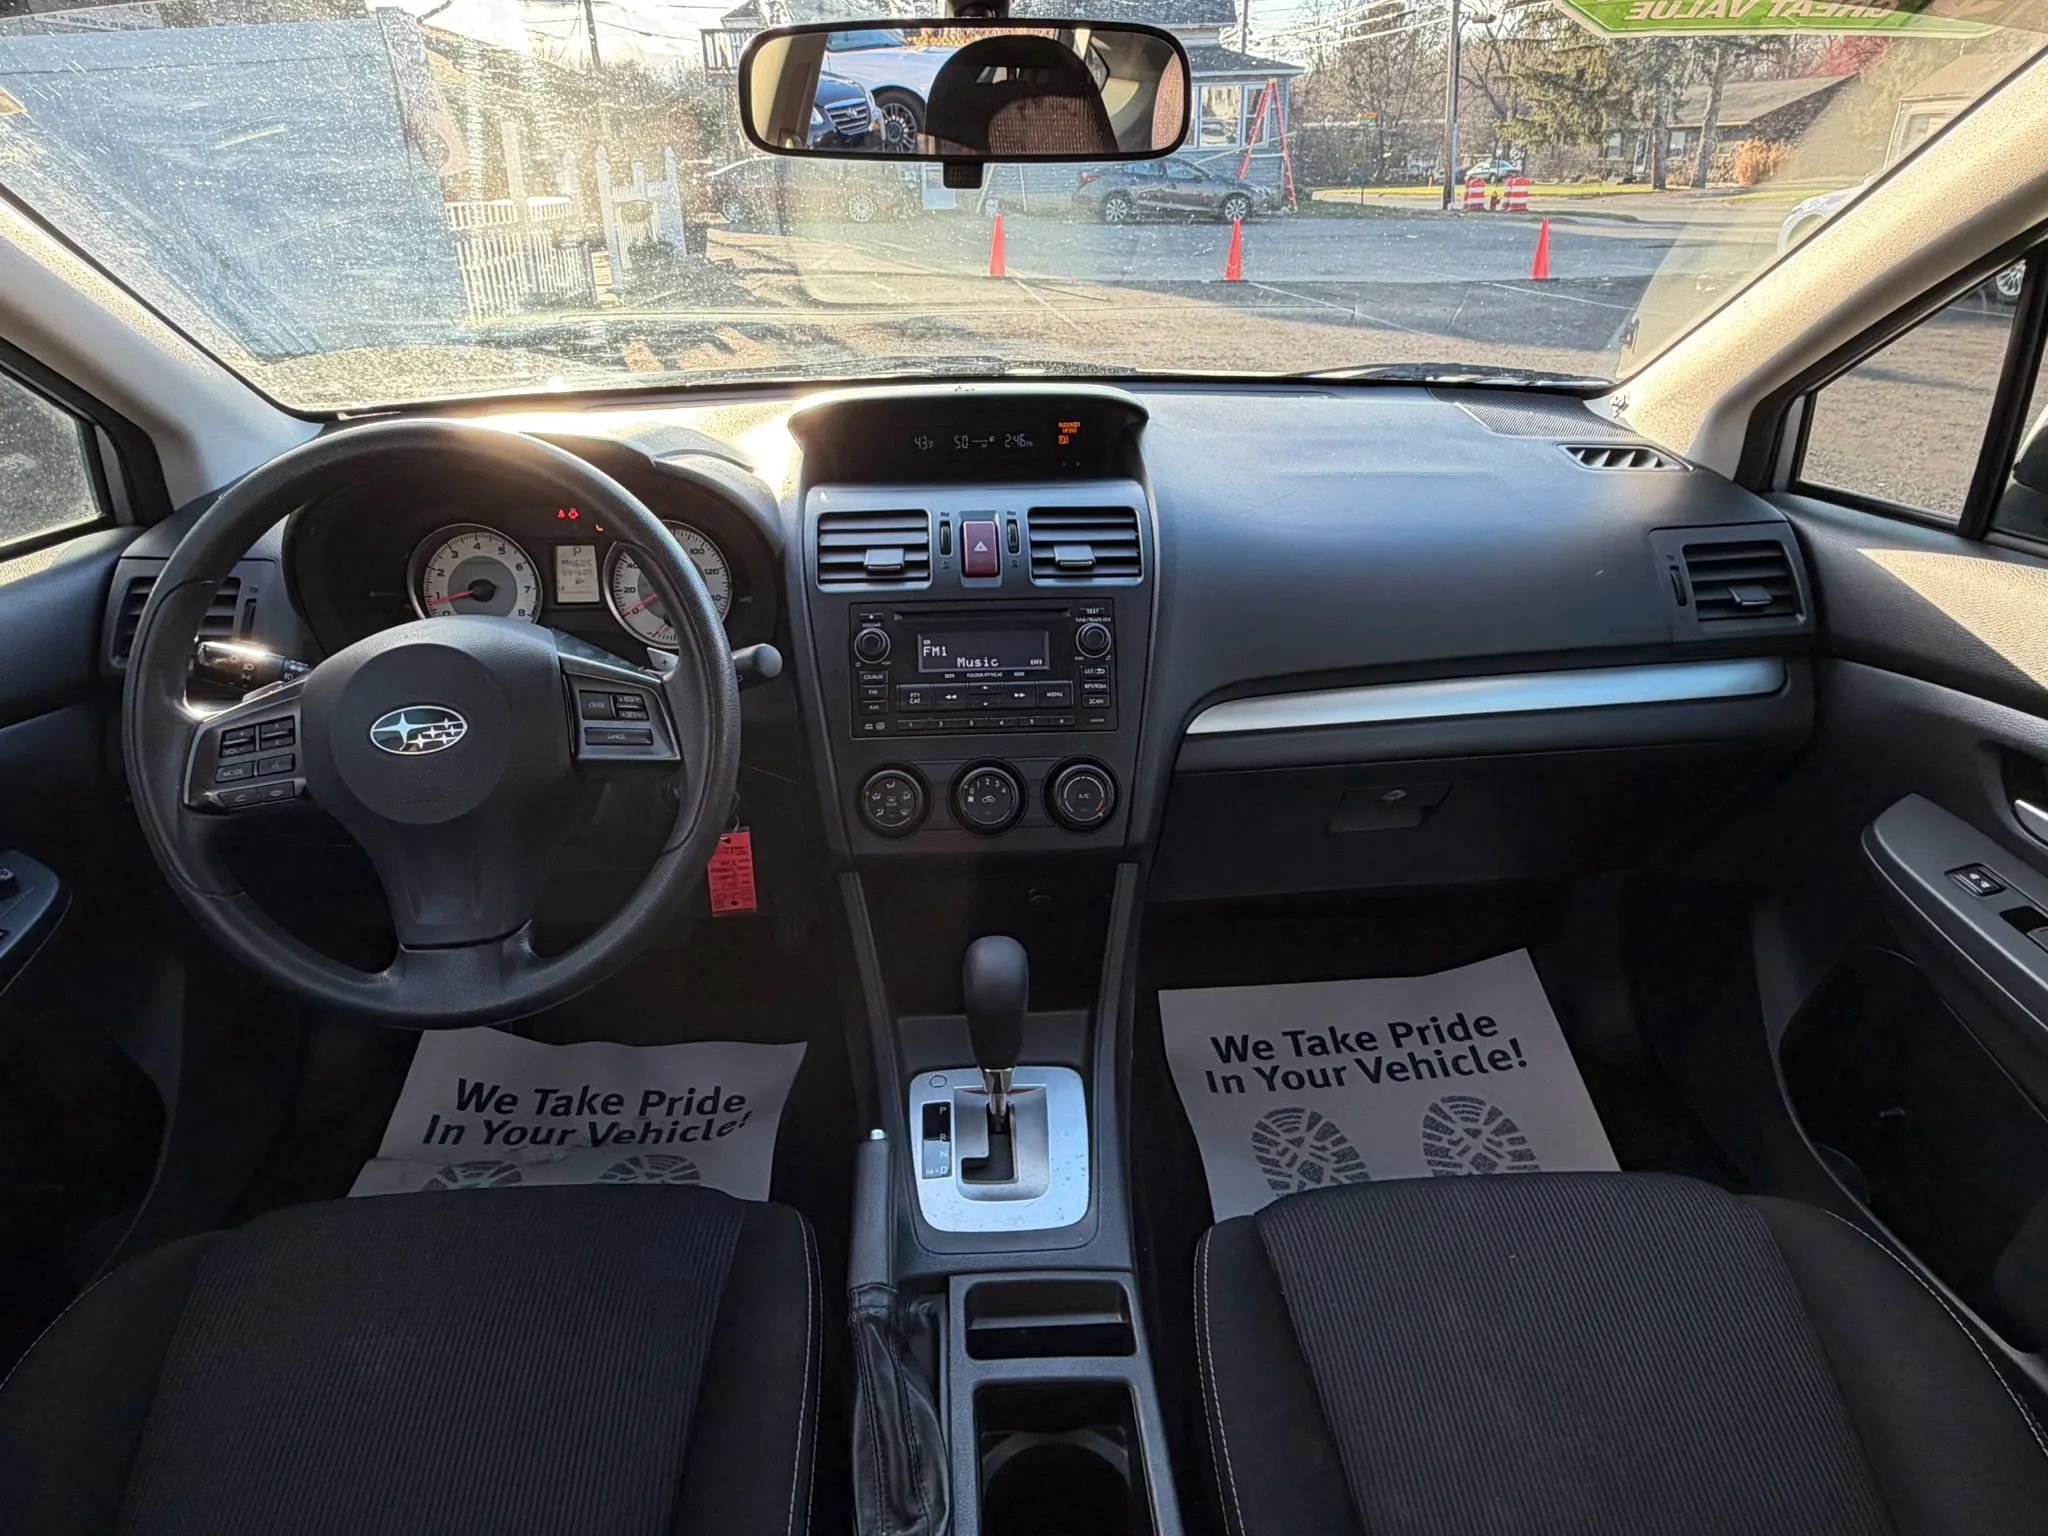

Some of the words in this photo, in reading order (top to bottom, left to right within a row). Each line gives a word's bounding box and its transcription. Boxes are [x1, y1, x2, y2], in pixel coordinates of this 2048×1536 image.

[473, 542, 481, 550] 4
[498, 546, 505, 555] 5
[451, 550, 459, 559] 3
[515, 563, 523, 571] 6
[437, 569, 445, 577] 2
[518, 609, 525, 617] 8
[923, 646, 947, 657] FM1
[957, 657, 999, 668] Music
[1210, 1034, 1275, 1063] We
[1281, 1026, 1378, 1057] Take
[1388, 1012, 1499, 1050] Pride
[1205, 1070, 1245, 1094] In
[1253, 1064, 1347, 1092] Your
[1354, 1038, 1528, 1085] Vehicle!
[456, 1078, 518, 1114] We
[533, 1085, 624, 1117] Take
[638, 1086, 747, 1117] Pride
[939, 1106, 947, 1115] P
[422, 1114, 466, 1146] In
[482, 1119, 577, 1146] Your
[588, 1110, 753, 1148] Vehicle!
[939, 1133, 948, 1141] R
[940, 1150, 948, 1158] N
[941, 1166, 948, 1174] D
